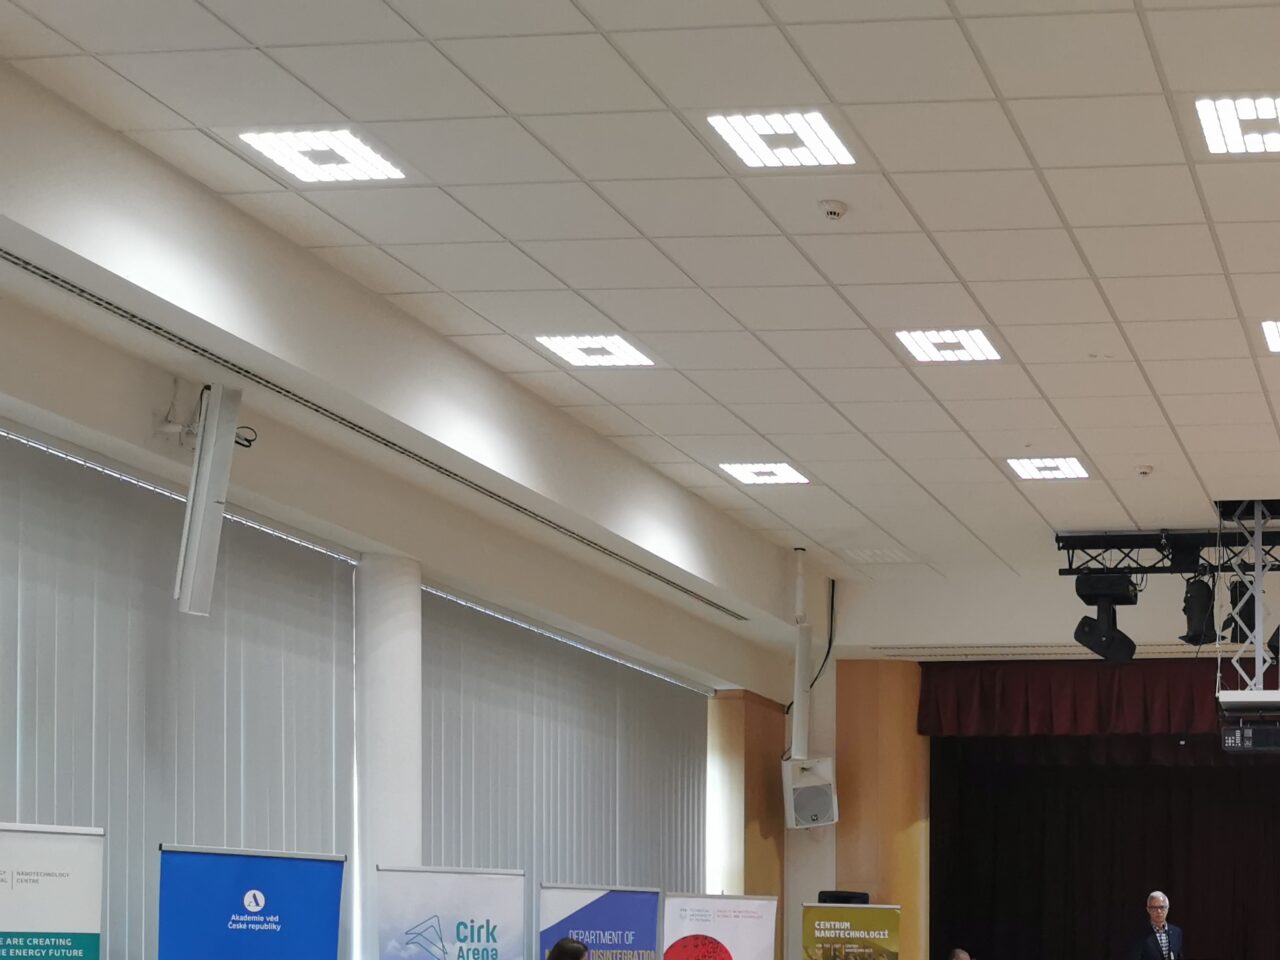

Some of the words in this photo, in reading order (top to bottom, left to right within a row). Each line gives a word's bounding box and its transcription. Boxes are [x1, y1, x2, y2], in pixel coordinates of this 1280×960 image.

[249, 923, 281, 931] republiky
[815, 921, 850, 929] CENTRUM
[456, 919, 498, 943] Cirk
[815, 930, 888, 938] NANOTECHNOLOGIÍ
[569, 930, 622, 945] DEPARTMENT
[624, 932, 635, 944] OF
[27, 938, 72, 946] CREATING
[49, 949, 84, 957] FUTURE
[457, 946, 498, 960] Arena
